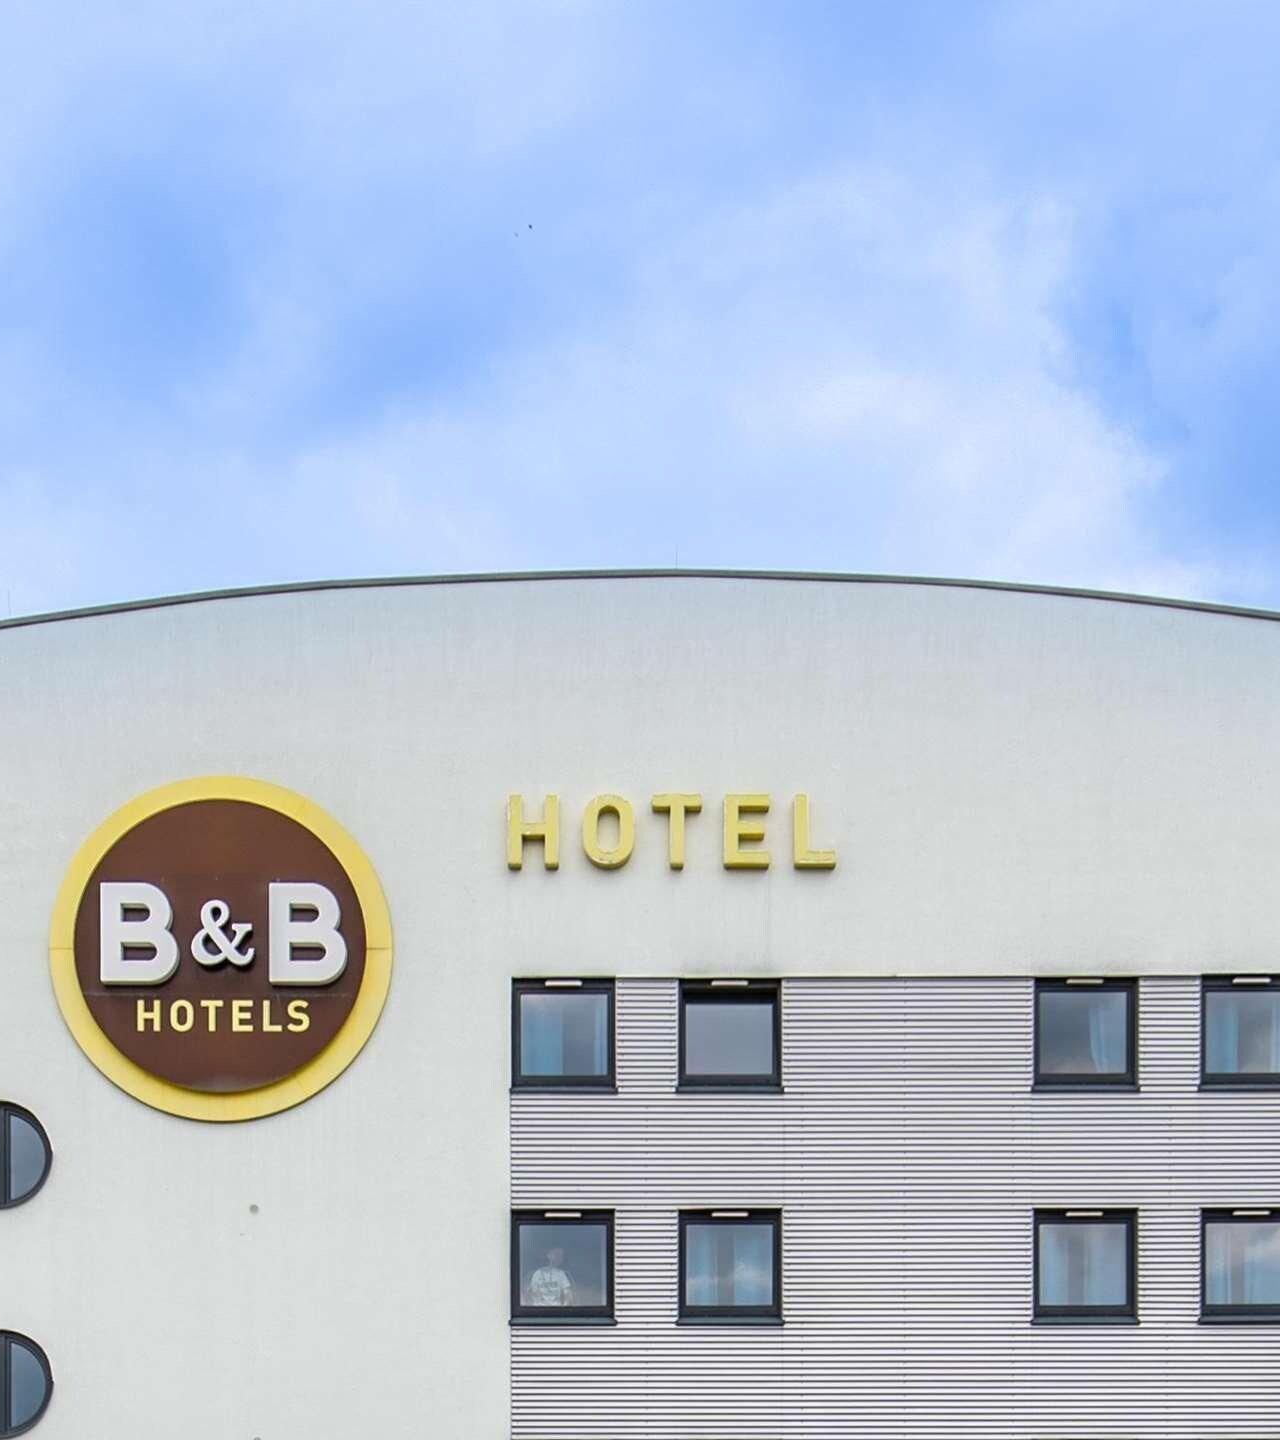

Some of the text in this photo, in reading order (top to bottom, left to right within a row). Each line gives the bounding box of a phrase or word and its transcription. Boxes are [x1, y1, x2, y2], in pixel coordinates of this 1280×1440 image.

[507, 793, 837, 871] HOTEL
[100, 882, 348, 986] B&B
[136, 1000, 311, 1032] HOTELS
